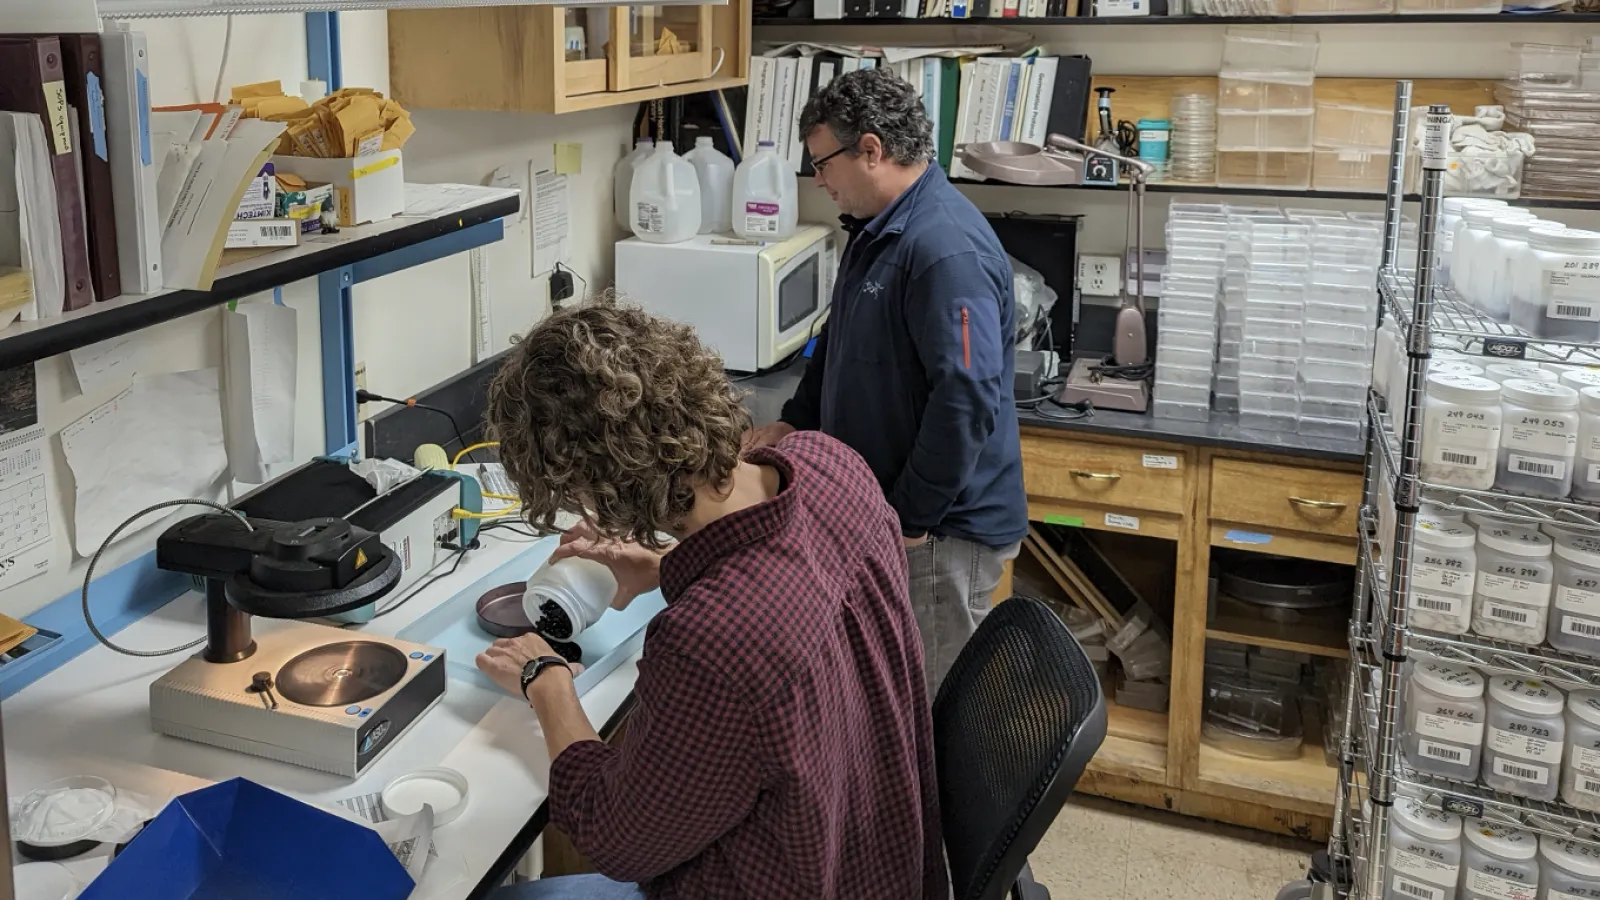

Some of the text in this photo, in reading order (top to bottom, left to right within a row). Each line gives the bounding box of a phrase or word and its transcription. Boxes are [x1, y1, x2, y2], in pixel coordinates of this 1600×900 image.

[1028, 112, 1038, 138] Protocols
[1542, 419, 1565, 429] 053
[1531, 726, 1549, 737] 723
